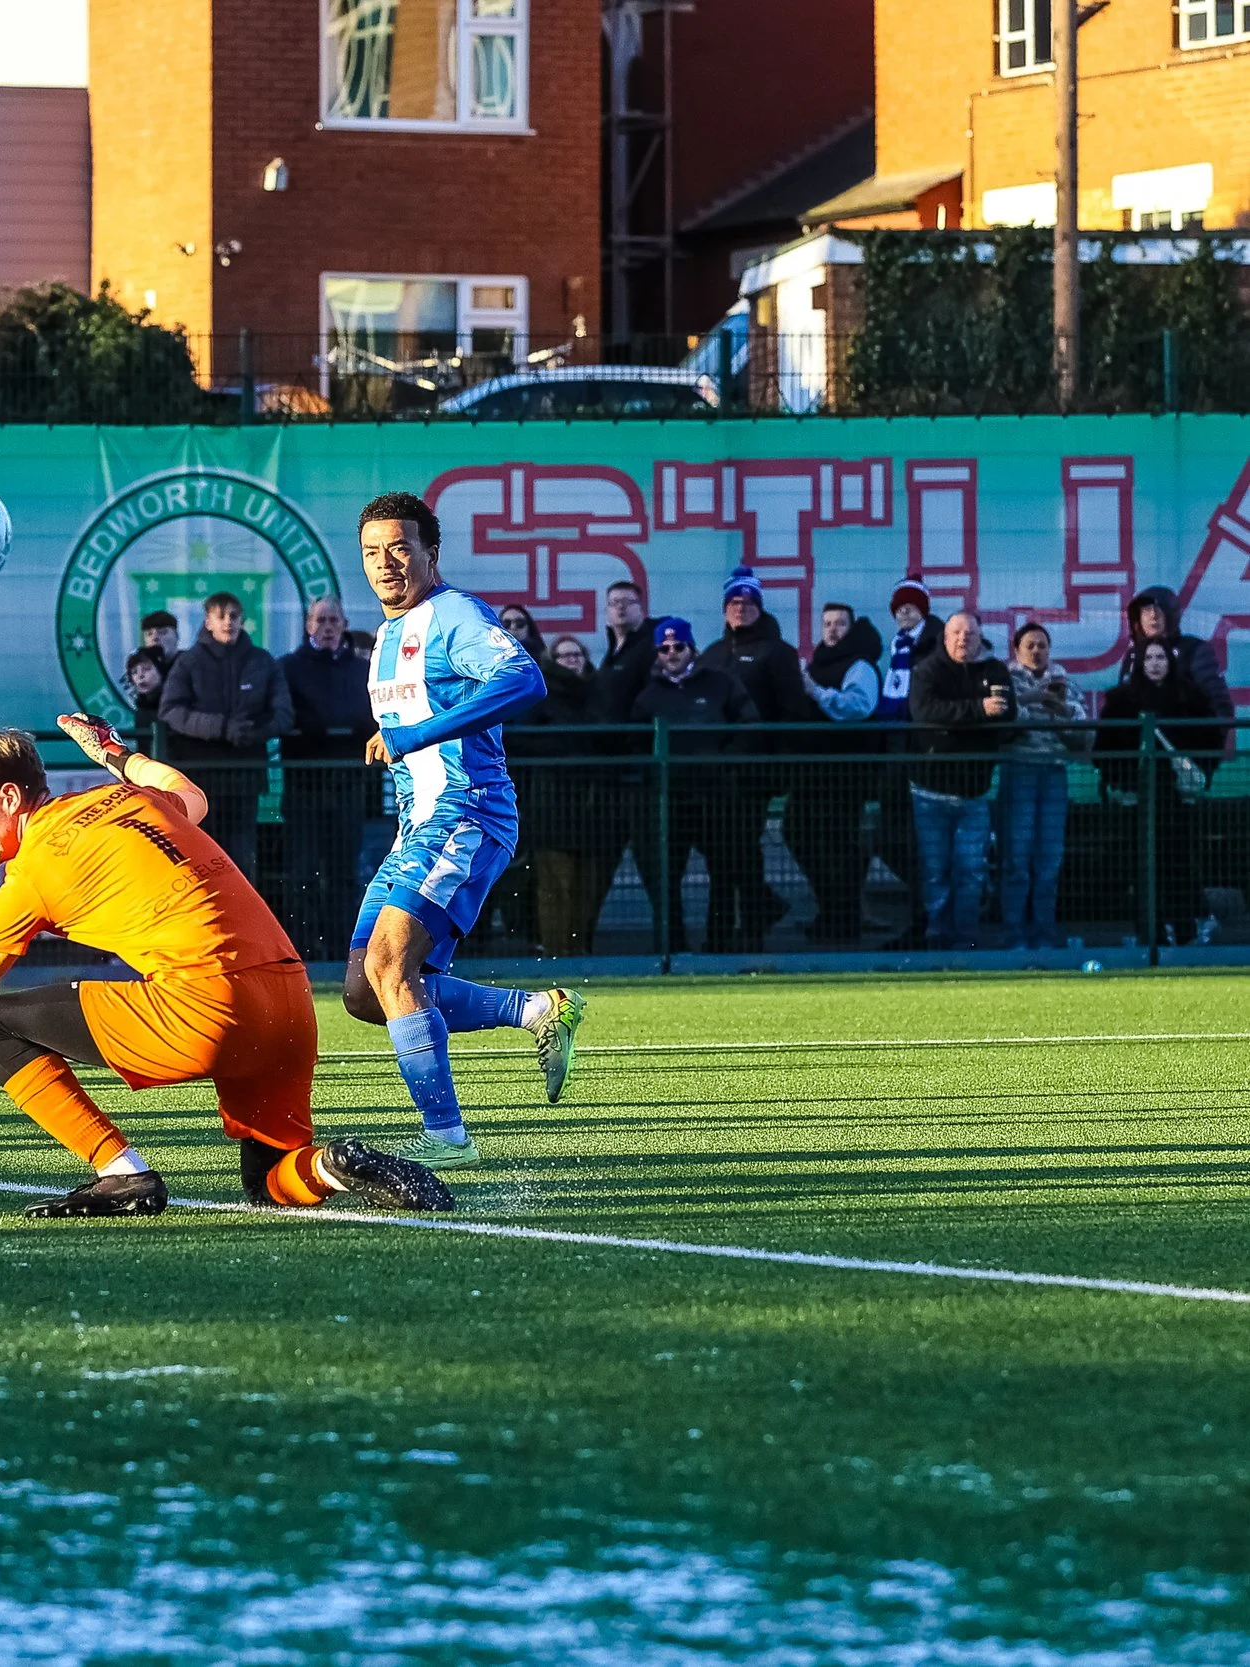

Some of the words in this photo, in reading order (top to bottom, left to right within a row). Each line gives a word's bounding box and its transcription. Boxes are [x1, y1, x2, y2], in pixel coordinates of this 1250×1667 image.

[68, 480, 234, 601] BEDWORTH
[243, 493, 332, 601] UNITED
[370, 683, 417, 704] TUART
